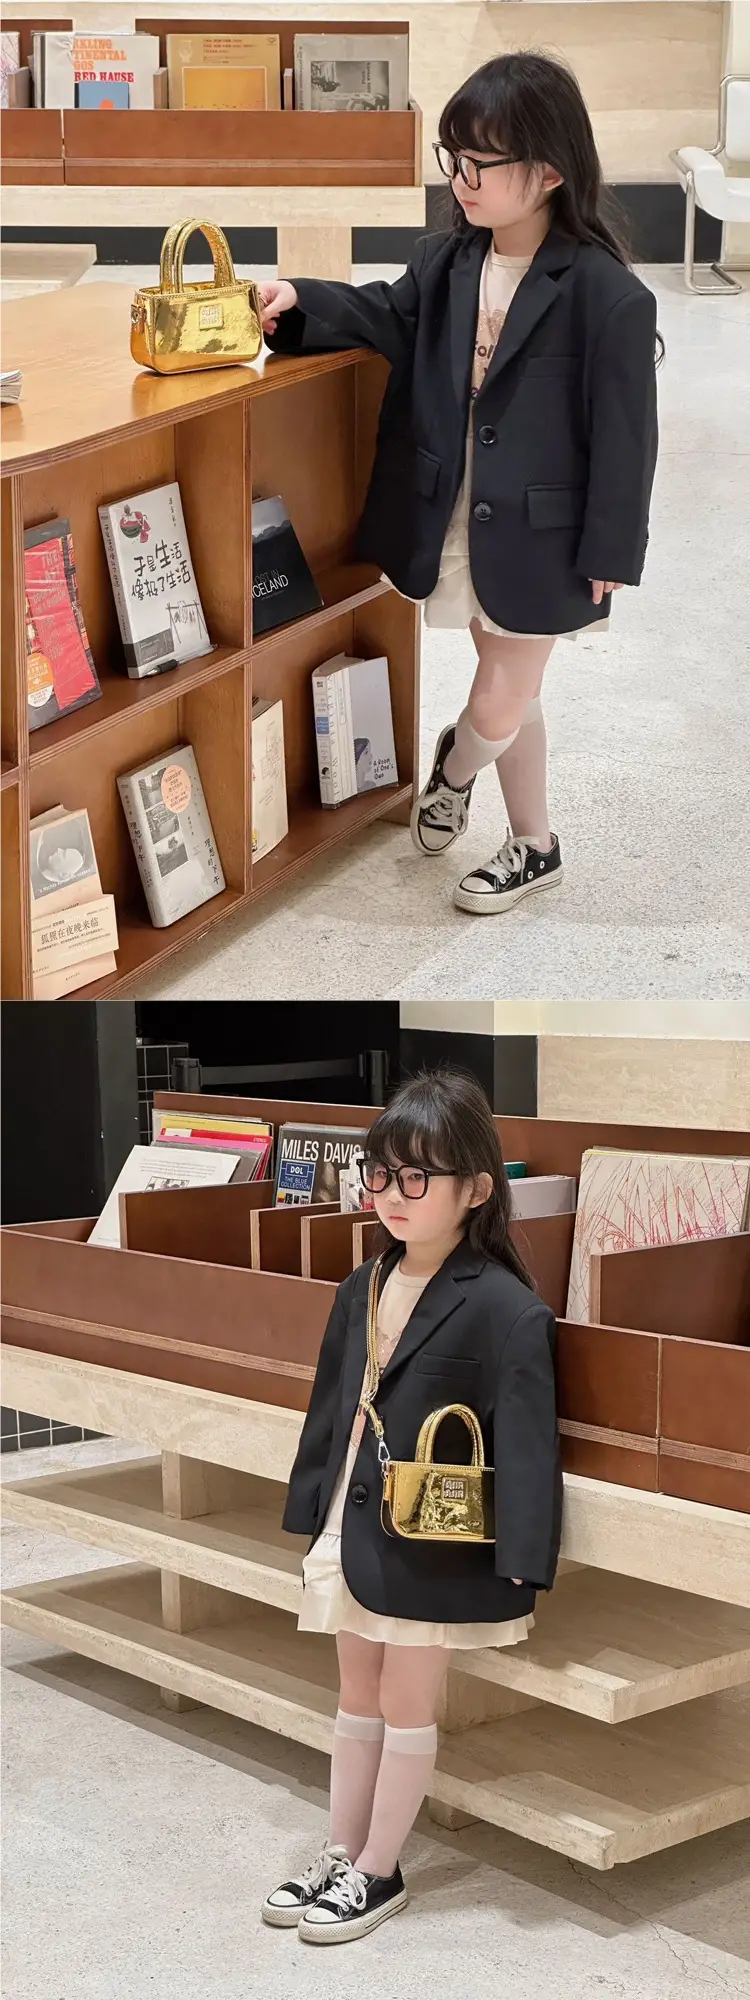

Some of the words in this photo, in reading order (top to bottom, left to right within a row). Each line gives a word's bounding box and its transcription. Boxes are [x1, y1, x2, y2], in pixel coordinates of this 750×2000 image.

[74, 71, 97, 82] RED
[99, 71, 135, 83] HAUSE
[281, 1138, 320, 1162] MILES
[290, 1165, 304, 1175] DOL
[280, 1181, 311, 1191] COLLECTION
